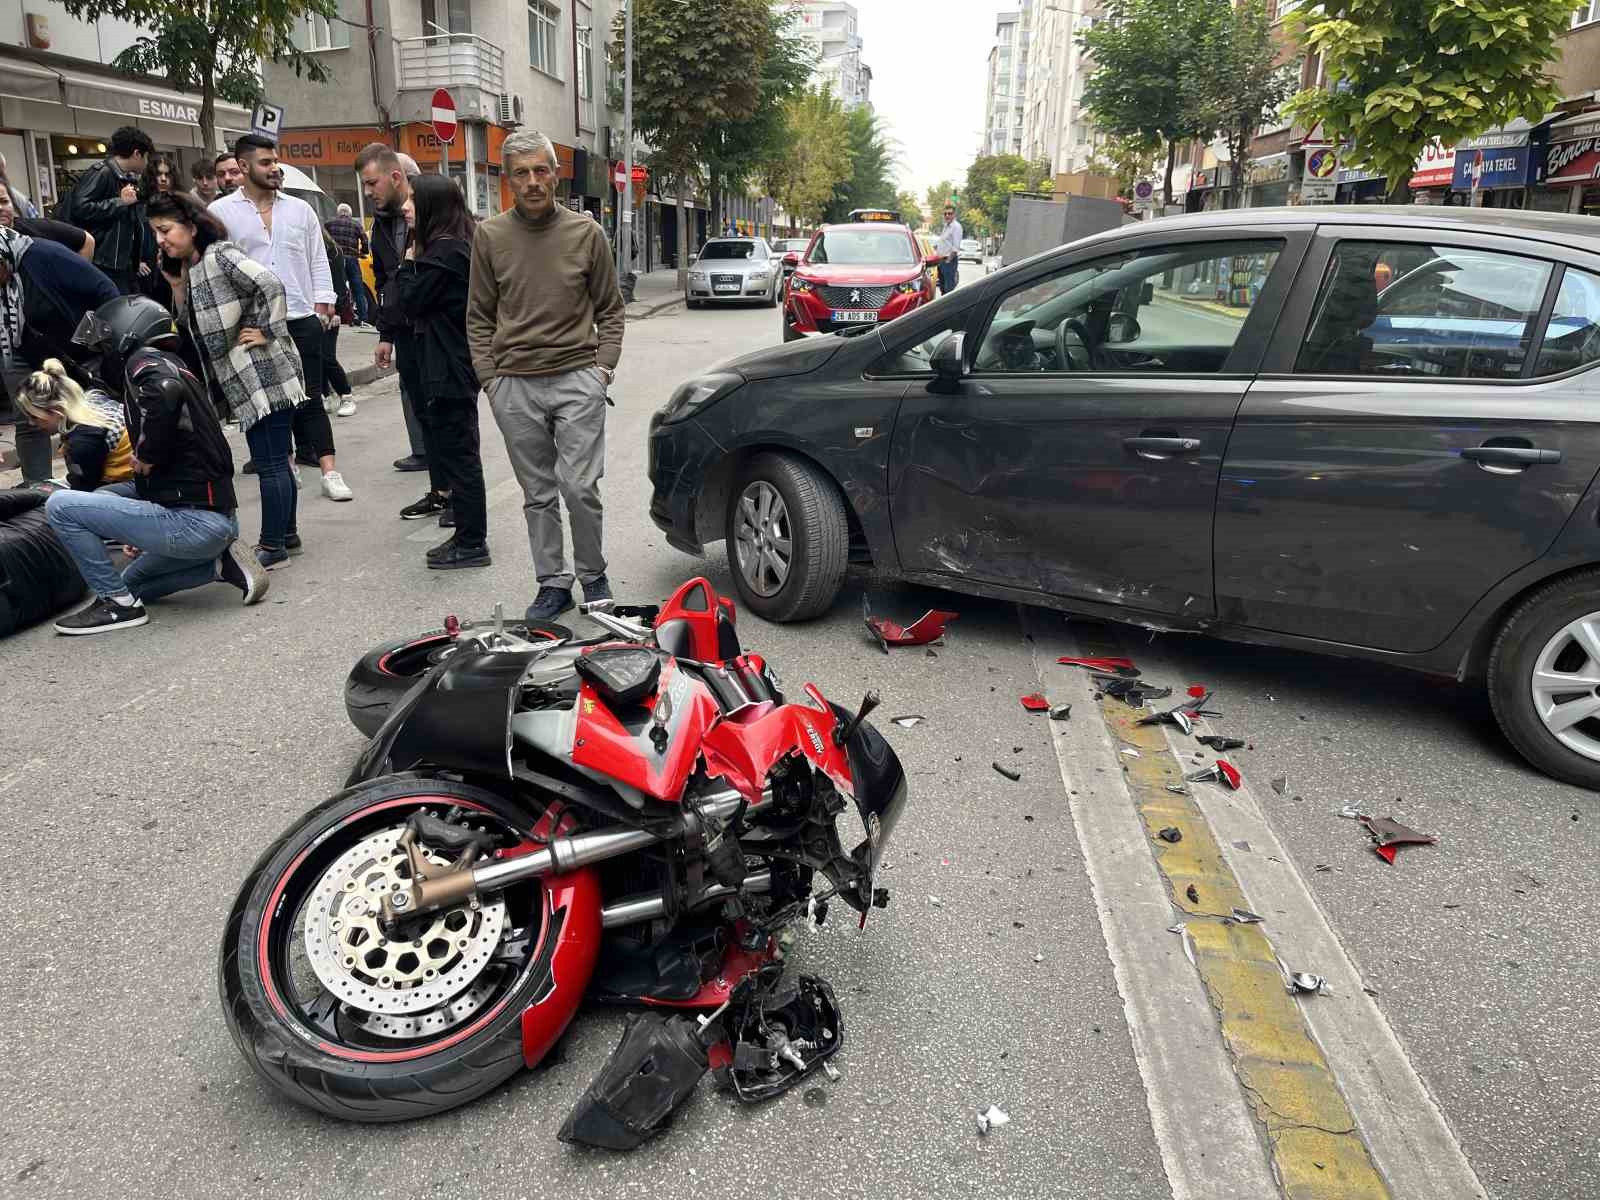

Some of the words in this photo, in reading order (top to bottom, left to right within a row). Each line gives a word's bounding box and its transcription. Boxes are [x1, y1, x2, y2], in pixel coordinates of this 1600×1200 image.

[138, 99, 199, 122] ESMAR
[262, 110, 276, 127] P
[279, 138, 323, 159] need
[1495, 158, 1517, 172] TEKEL
